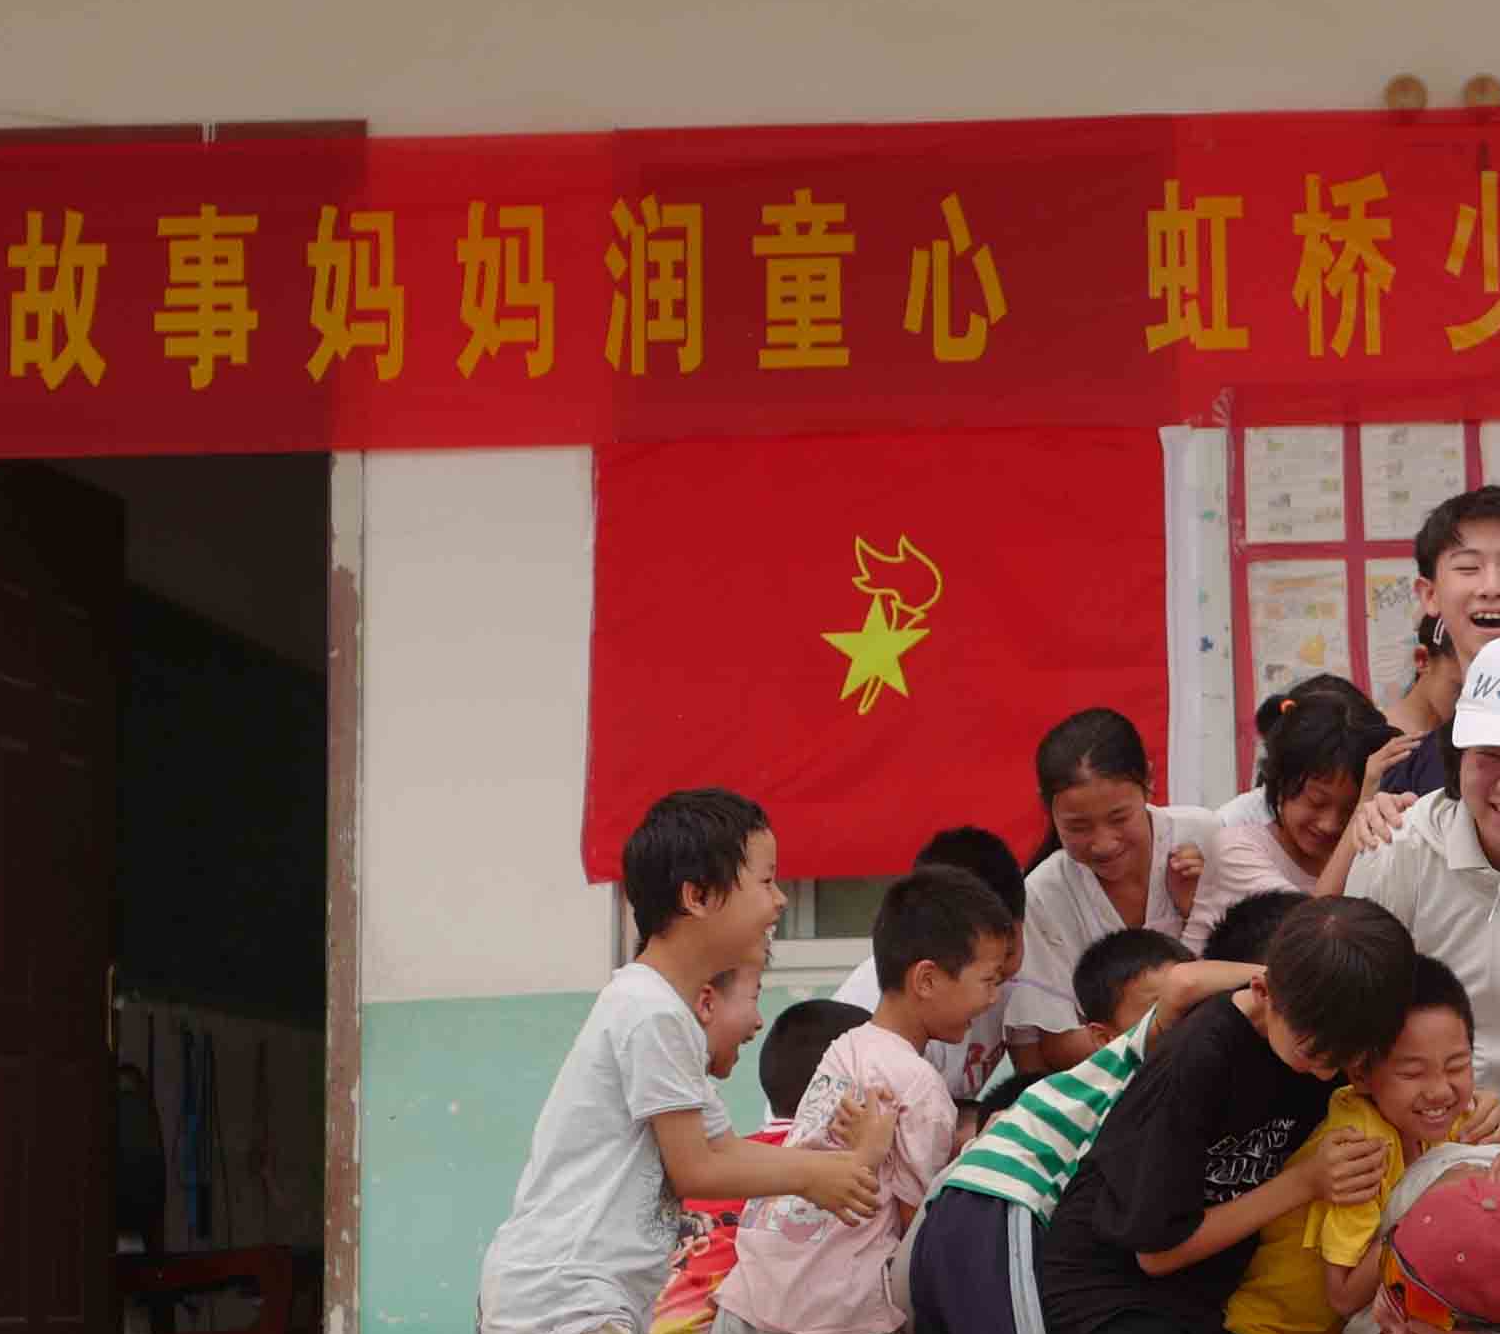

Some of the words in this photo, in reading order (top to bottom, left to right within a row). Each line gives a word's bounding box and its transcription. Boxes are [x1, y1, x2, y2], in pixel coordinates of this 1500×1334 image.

[6, 187, 1008, 391] 故事妈妈润童心
